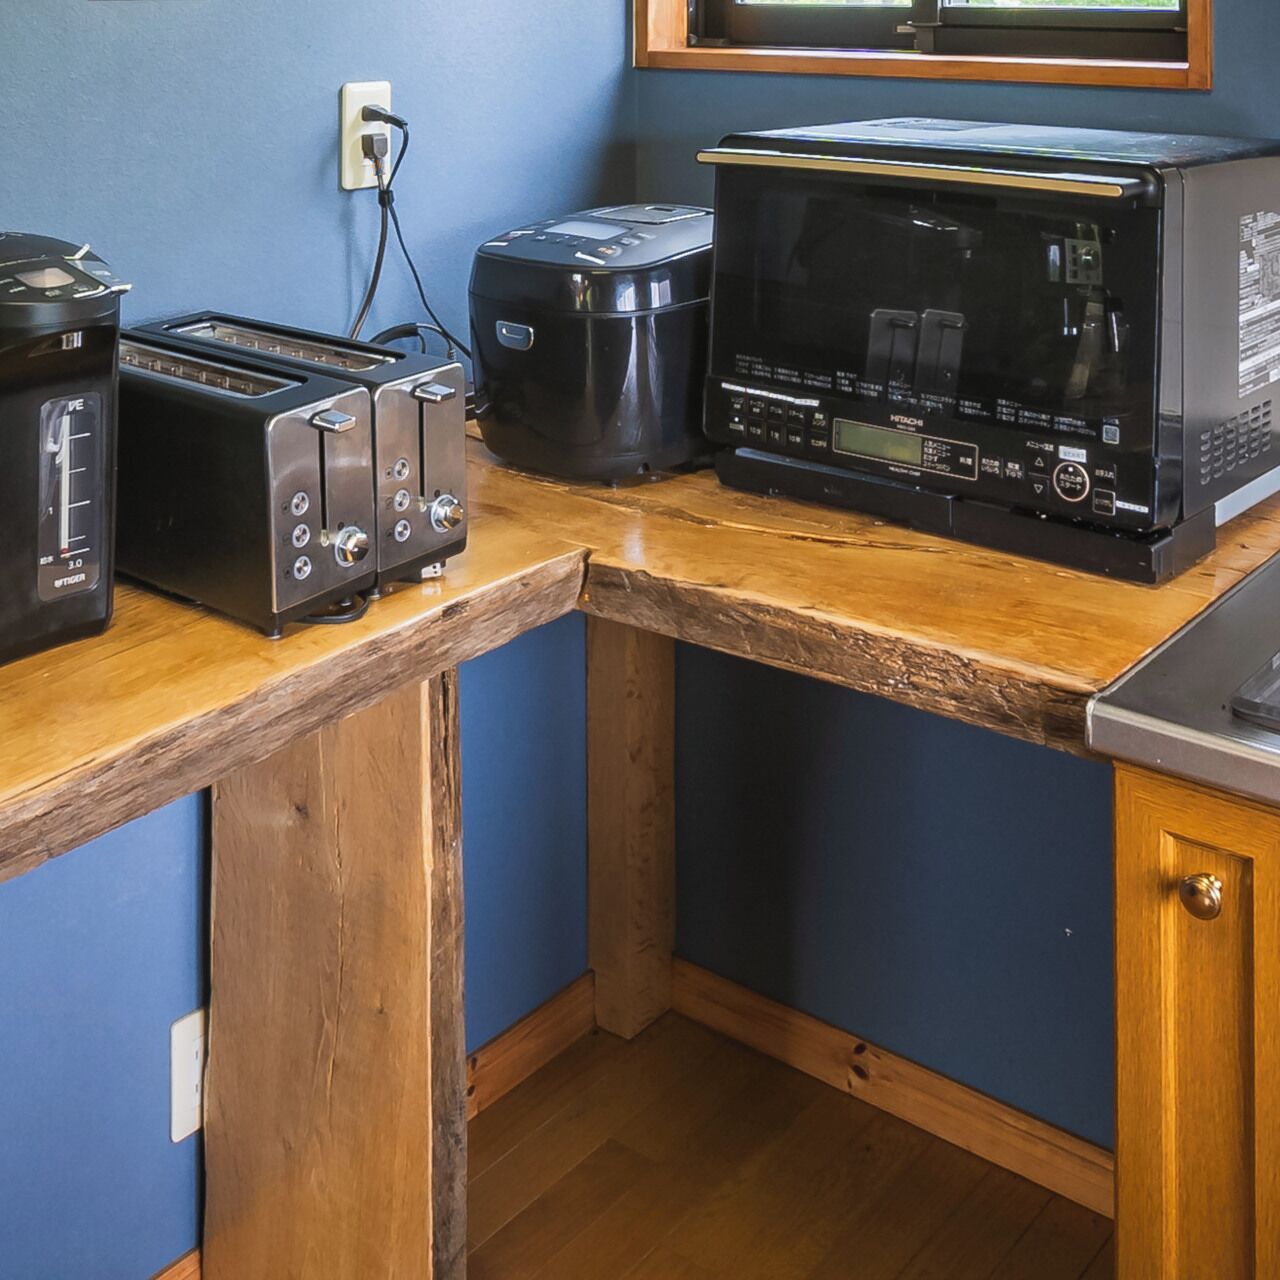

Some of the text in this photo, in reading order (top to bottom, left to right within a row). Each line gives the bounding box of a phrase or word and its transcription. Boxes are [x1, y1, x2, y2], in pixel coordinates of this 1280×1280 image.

[890, 414, 924, 427] HITACHI
[68, 558, 83, 570] 3.0
[62, 573, 86, 586] TIGER
